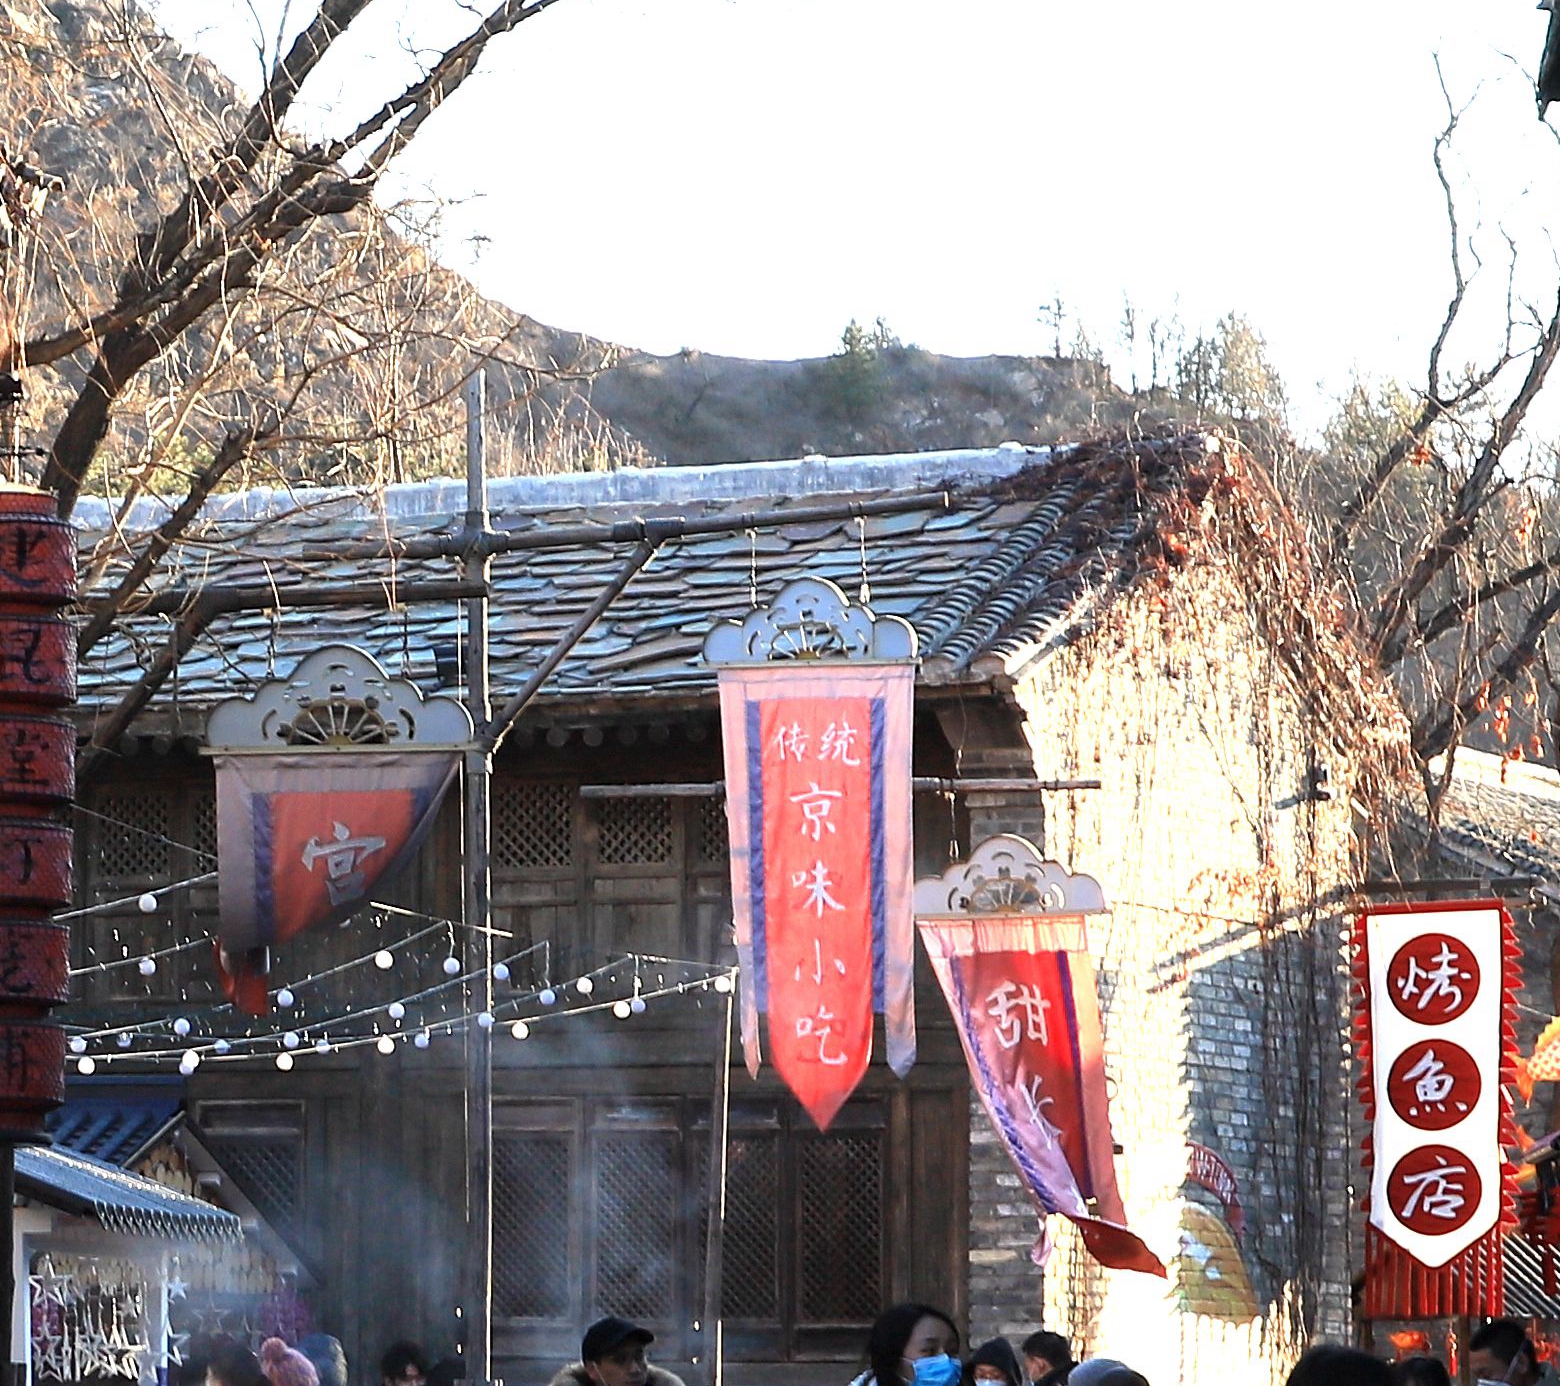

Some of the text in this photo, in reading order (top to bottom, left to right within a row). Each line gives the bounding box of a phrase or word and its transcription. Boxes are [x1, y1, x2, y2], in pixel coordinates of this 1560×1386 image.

[772, 719, 861, 766] 传统
[789, 781, 848, 1066] 京味小吃
